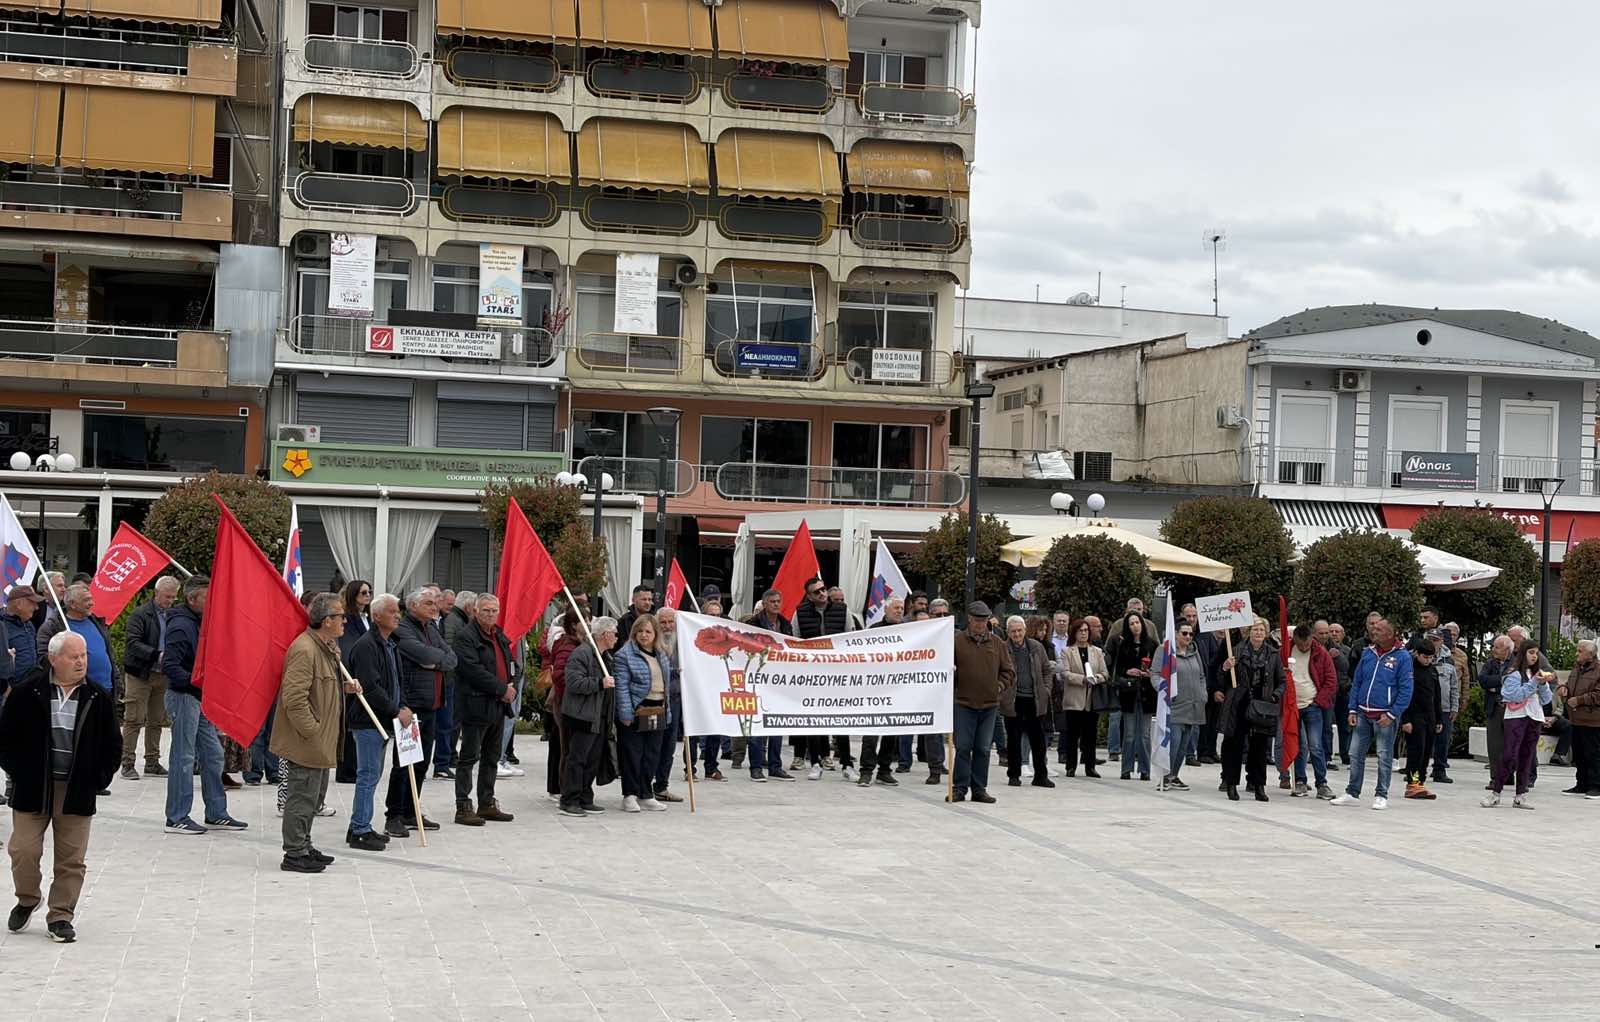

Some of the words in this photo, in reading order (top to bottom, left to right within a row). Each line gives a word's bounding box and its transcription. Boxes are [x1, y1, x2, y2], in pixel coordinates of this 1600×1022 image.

[486, 305, 514, 314] STARS
[400, 328, 460, 338] ΕΚΠΑΙΔΕΥΤΙΚΑ
[464, 331, 497, 340] ΚΕΝΤΡΑ
[874, 352, 920, 362] ΟΜΟΣΠΟΝΔΙΑ
[319, 454, 422, 470] ΣΥΝΕΤΑΙΡΙΣΤΙΚΗ
[425, 458, 480, 472] ΤΡΑΠΕΖΑ
[446, 473, 489, 482] COOPERATIVE
[845, 638, 864, 647] 140
[865, 635, 904, 646] ΧΡΟΝΙΑ
[767, 651, 808, 662] ΕΜΕΙΣ
[811, 652, 867, 663] ΧΤΙΣΑΜΕ
[868, 652, 894, 663] ΤΟΝ
[896, 648, 936, 662] ΚΟΣΜΟ
[748, 672, 770, 685] ΔΕΝ
[771, 674, 787, 686] ΘΑ
[789, 674, 848, 687] ΑΦΗΣΟΥΜΕ
[849, 675, 863, 687] ΝΑ
[866, 674, 886, 686] ΤΟΝ
[886, 671, 948, 685] ΓΚΡΕΜΙΣΟΥΝ
[722, 697, 757, 711] ΜΑΗ
[802, 698, 815, 707] ΟΙ
[817, 697, 864, 707] ΠΟΛΕΜΟΙ
[866, 697, 893, 706] ΤΟΥΣ
[766, 716, 809, 727] ΣΥΛΛΟΓΟΣ
[809, 716, 872, 726] ΣΥΝΤΑΞΙΟΥΧΩΝ
[873, 716, 888, 725] ΙΚΑ
[888, 715, 932, 725] ΤΥΡΝΑΒΟΥ
